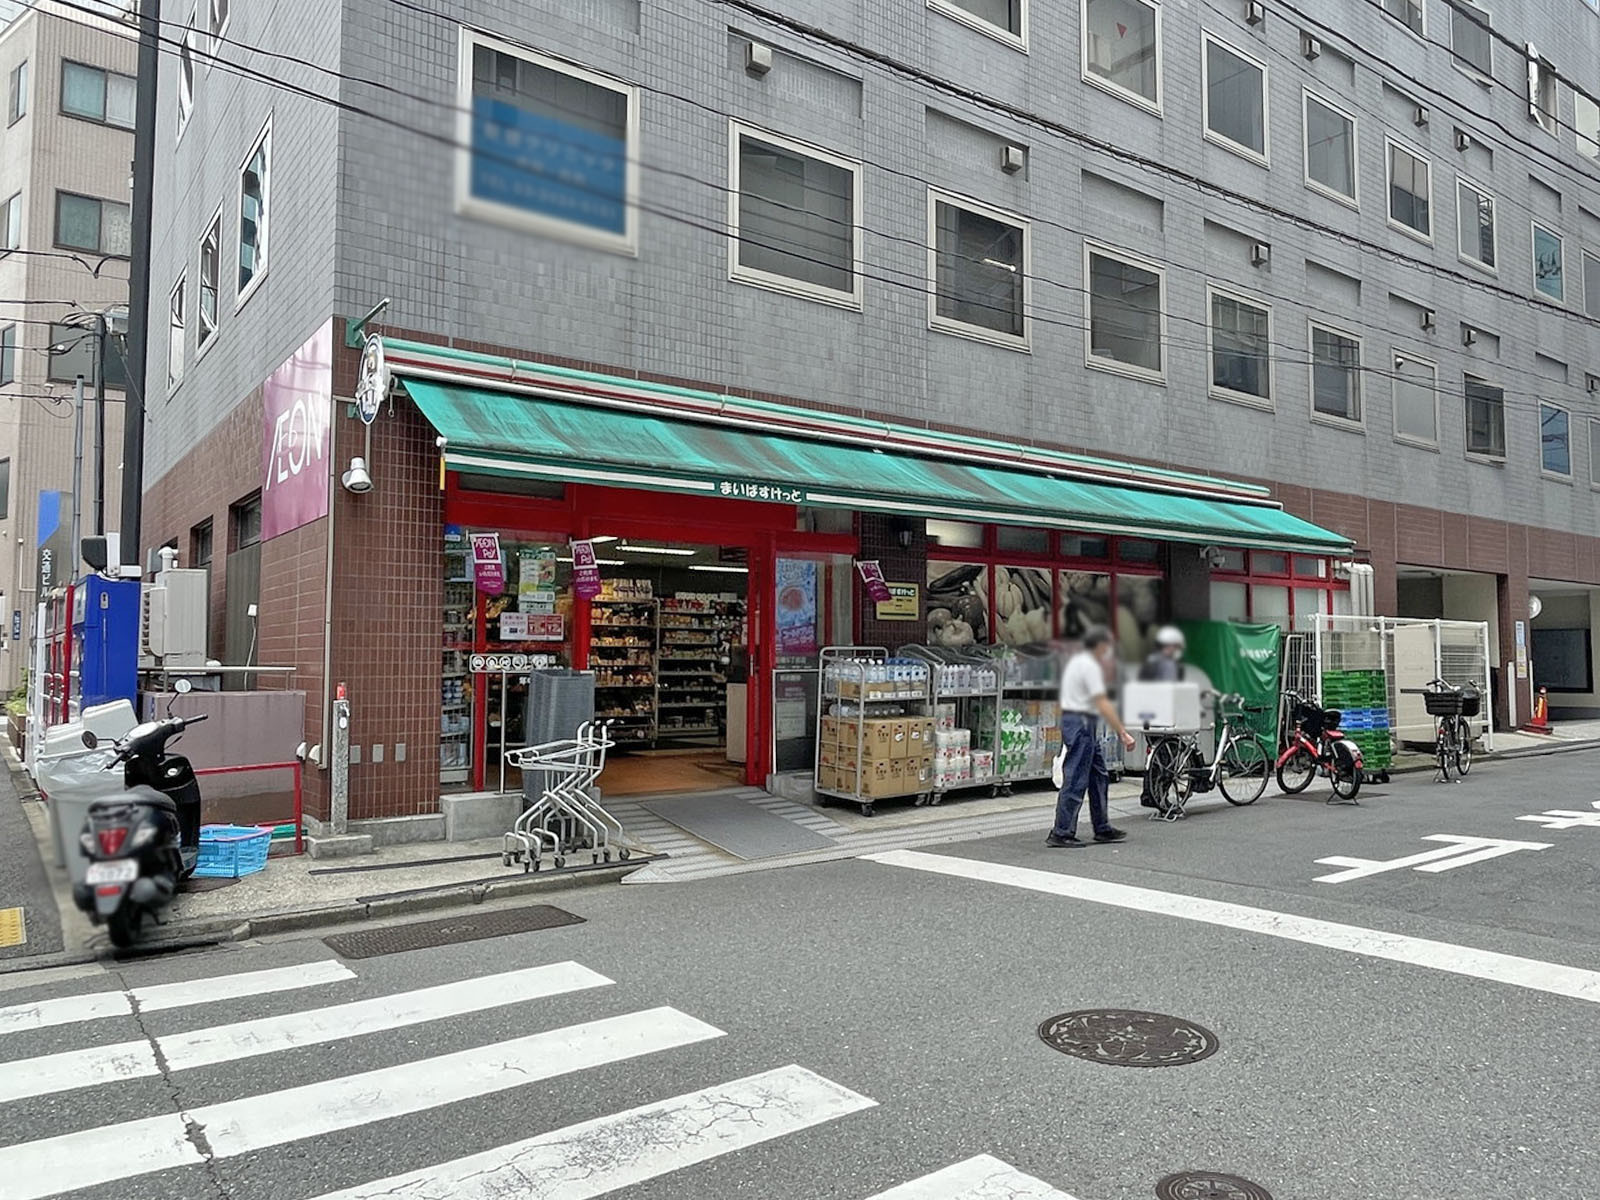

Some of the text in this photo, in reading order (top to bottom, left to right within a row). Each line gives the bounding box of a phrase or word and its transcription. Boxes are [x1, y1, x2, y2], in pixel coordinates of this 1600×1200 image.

[720, 481, 802, 502] まいばすけっと
[40, 548, 52, 598] 交通ビル
